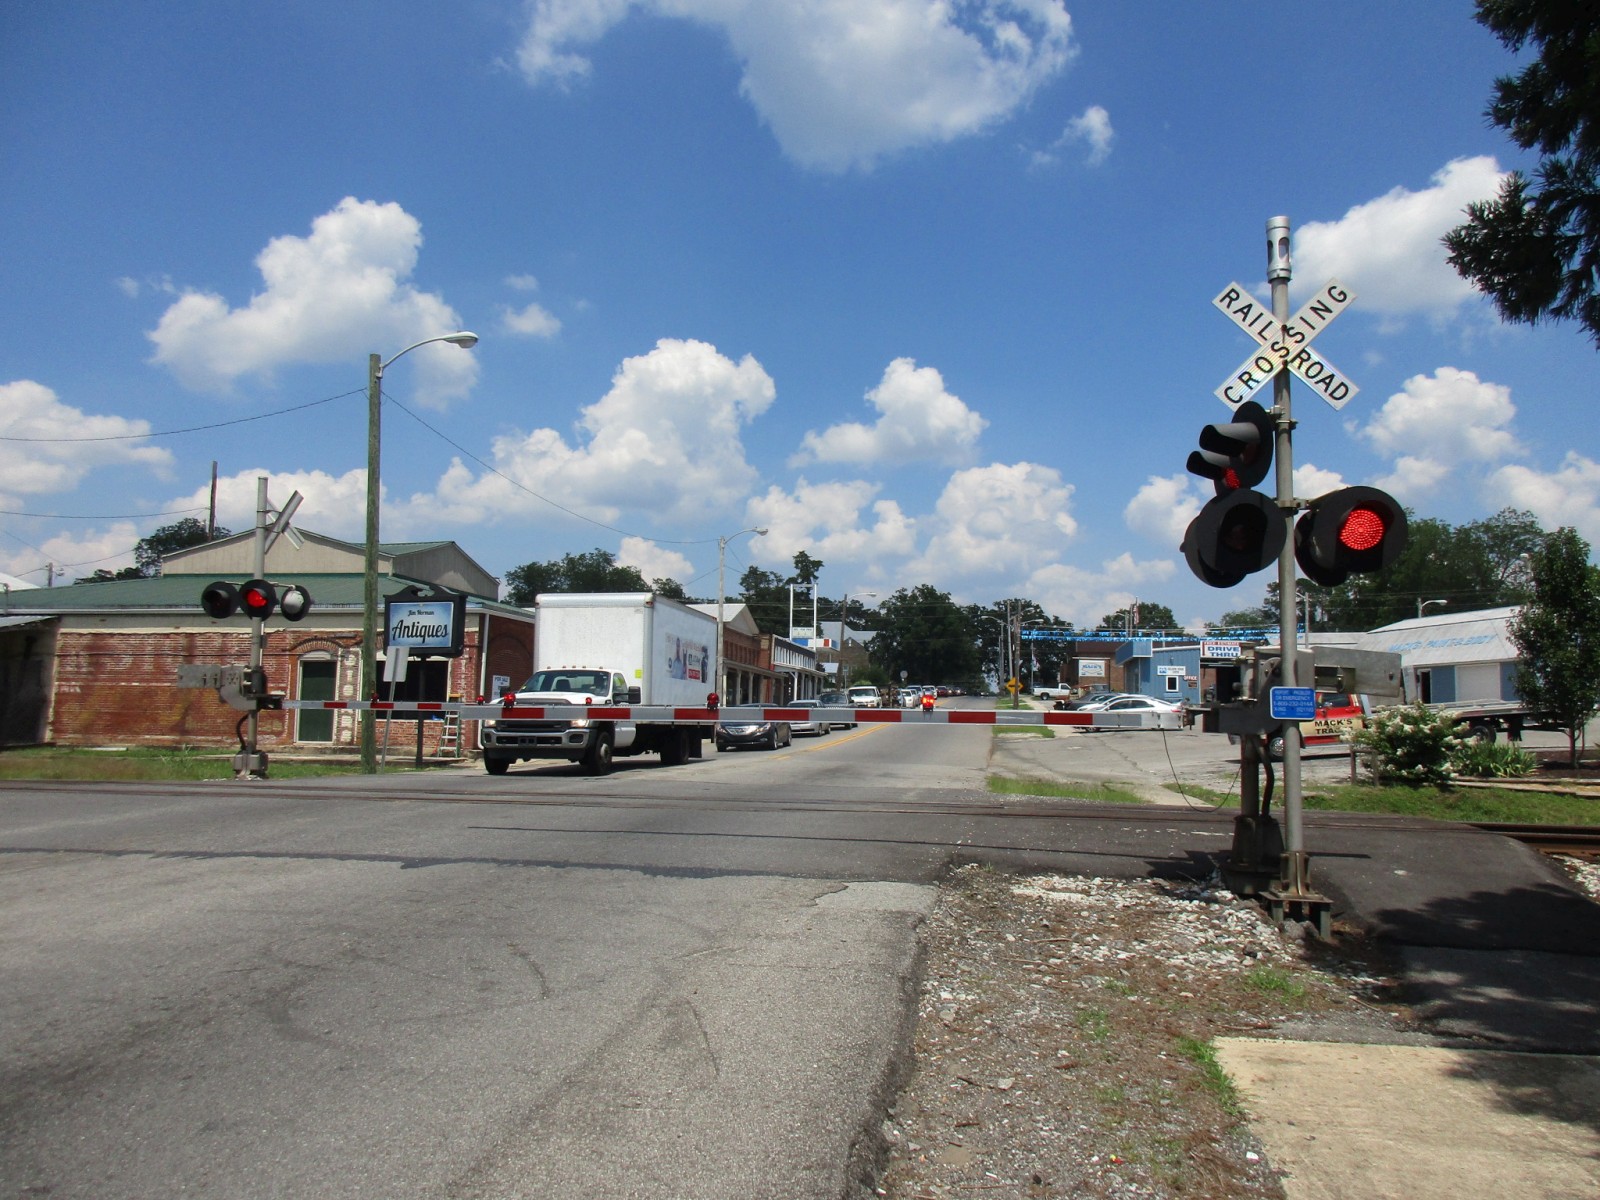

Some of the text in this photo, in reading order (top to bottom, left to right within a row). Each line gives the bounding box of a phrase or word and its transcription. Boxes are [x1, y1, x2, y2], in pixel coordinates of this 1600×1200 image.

[1223, 285, 1348, 404] CROSSING
[391, 619, 449, 644] Antiques
[1314, 718, 1353, 727] MACK'S
